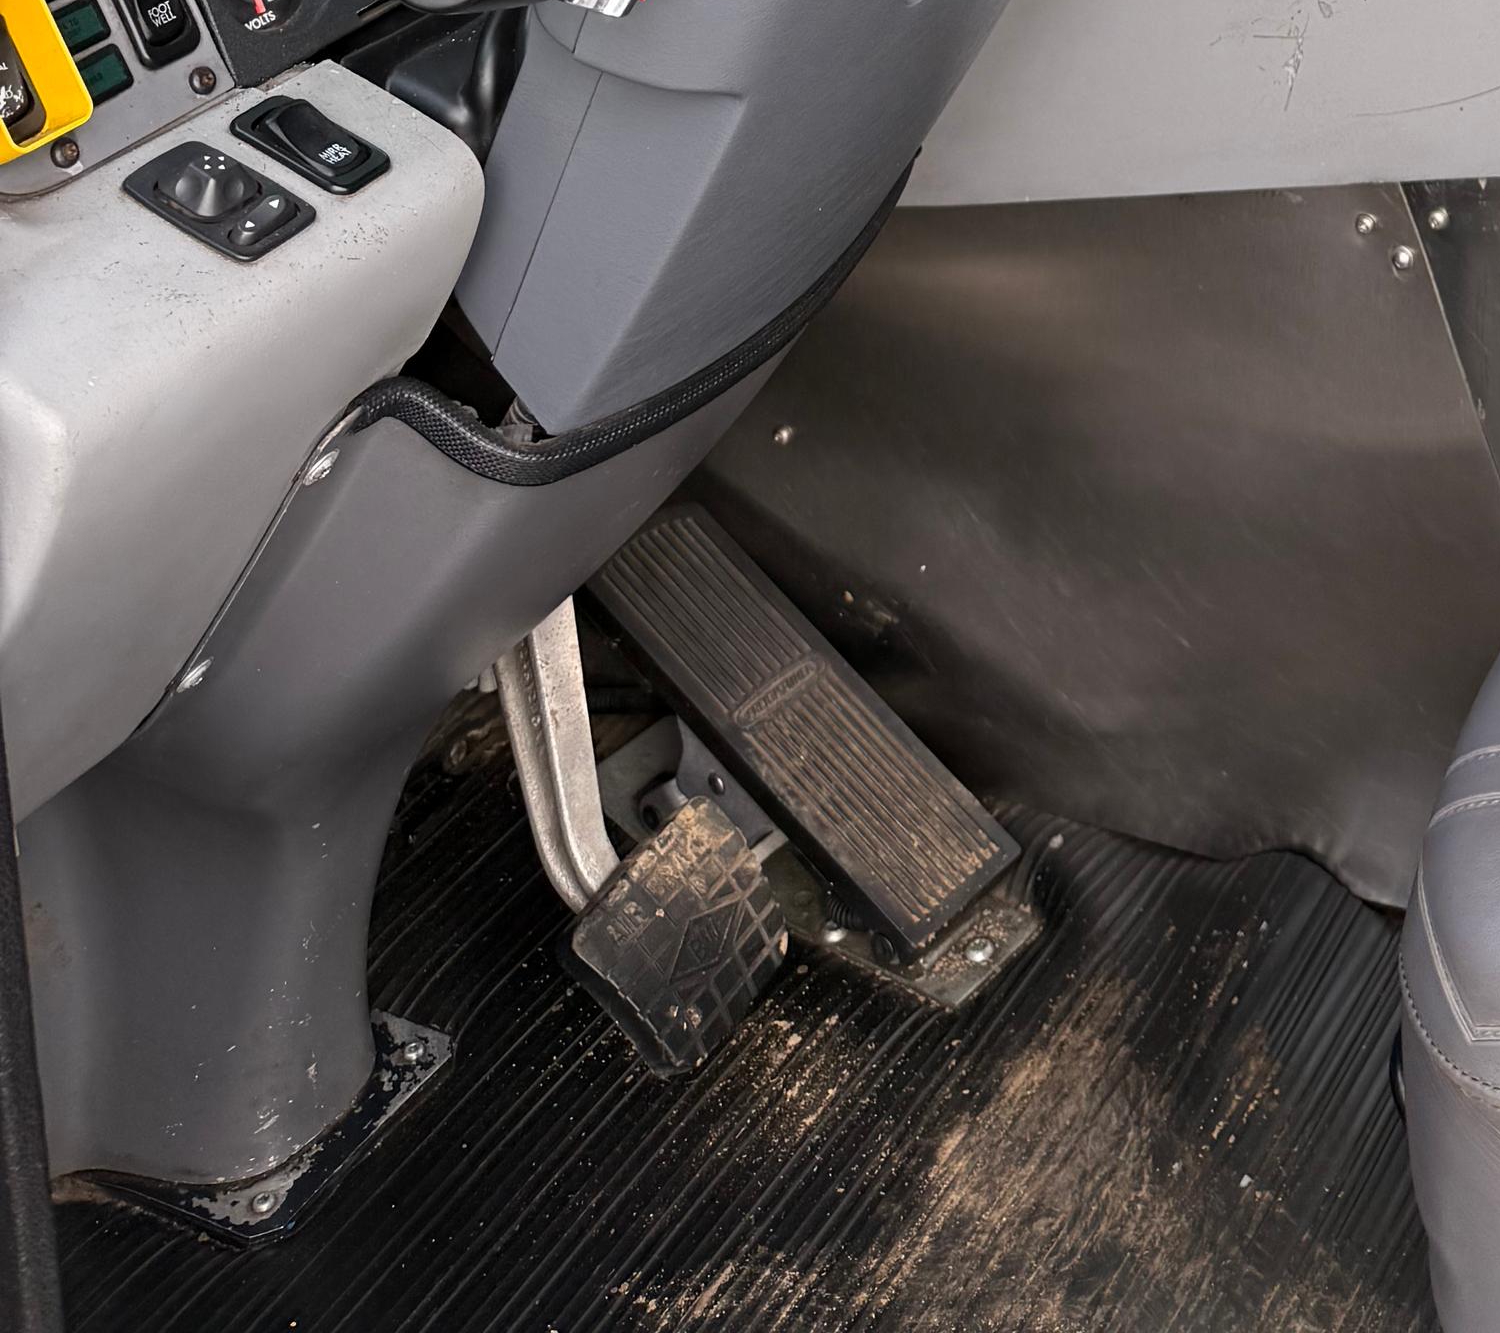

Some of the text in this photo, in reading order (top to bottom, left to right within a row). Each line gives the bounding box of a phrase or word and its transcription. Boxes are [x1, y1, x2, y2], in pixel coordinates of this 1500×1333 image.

[147, 0, 173, 17] FOOT
[151, 10, 177, 29] WELL
[244, 10, 277, 32] VOLTS
[318, 143, 342, 161] MIRR
[325, 147, 352, 165] HEAT
